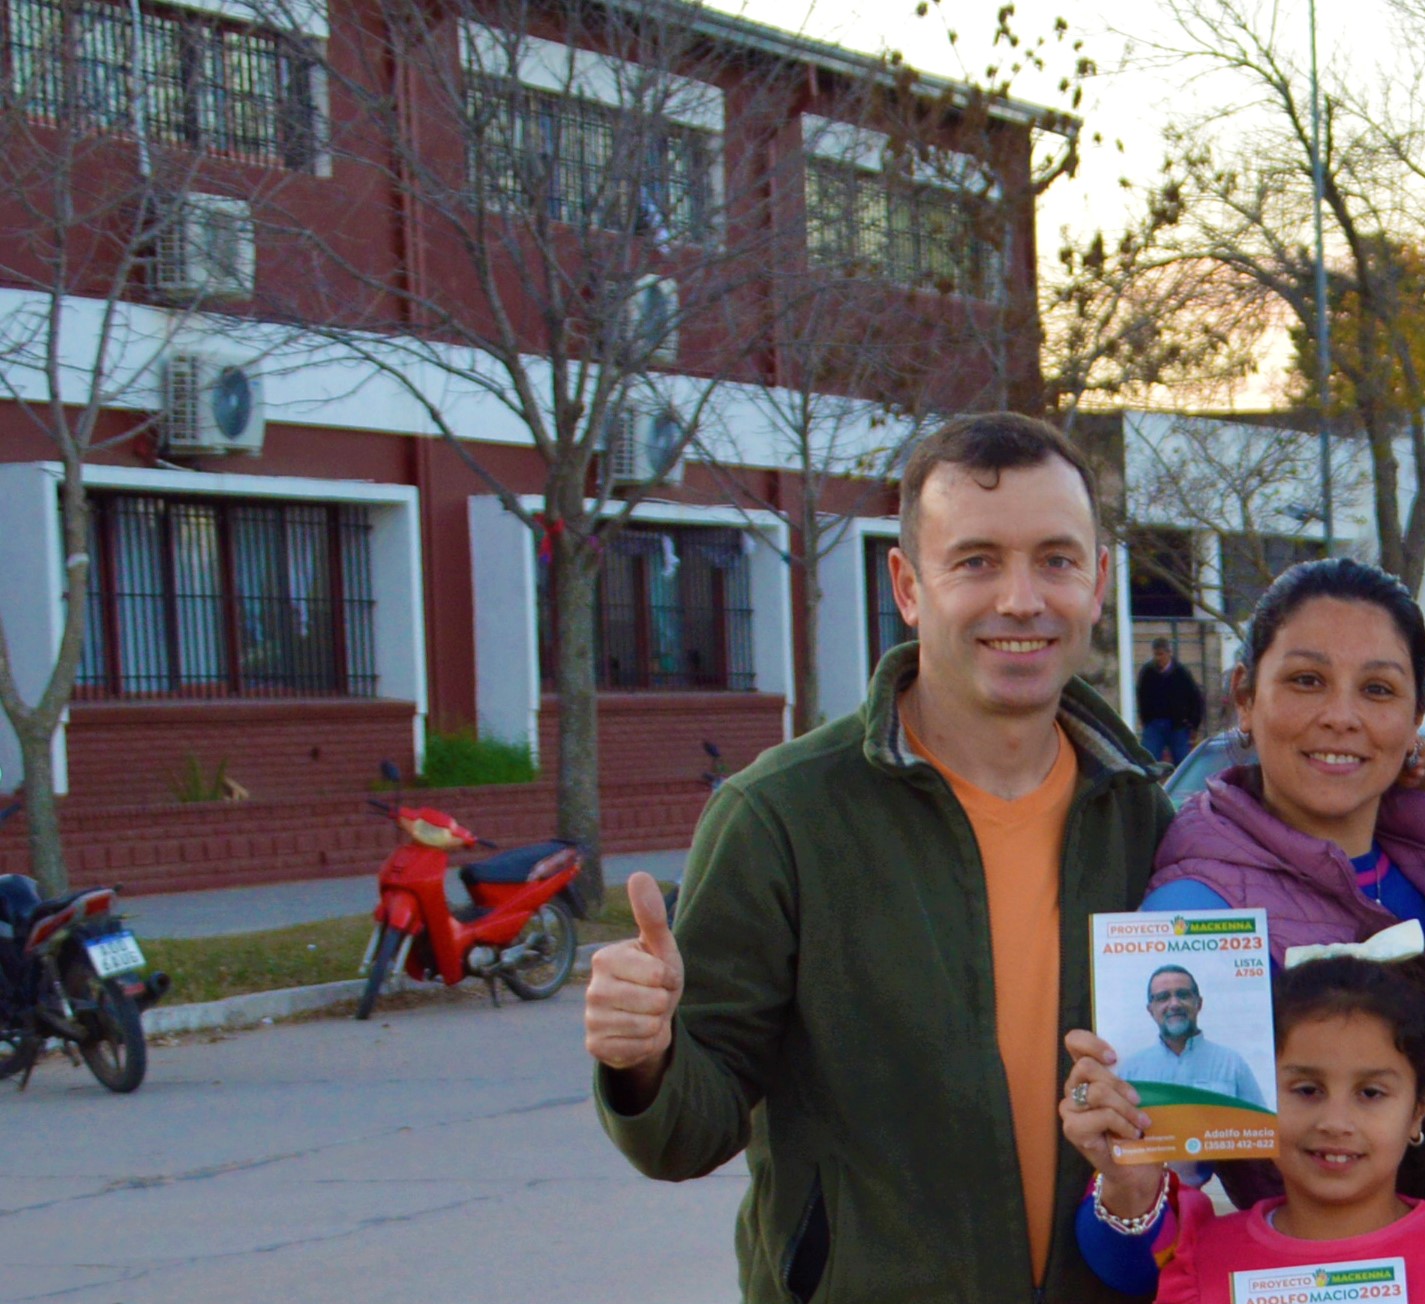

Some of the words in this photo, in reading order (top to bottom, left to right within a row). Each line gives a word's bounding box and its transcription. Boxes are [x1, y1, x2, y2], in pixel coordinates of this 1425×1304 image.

[1110, 923, 1170, 935] PROYECTO
[1190, 920, 1253, 932] MACKENNA
[1234, 958, 1264, 968] LISTA
[1204, 1129, 1240, 1138] Adolfo
[1243, 1128, 1275, 1137] Macio
[1252, 1276, 1311, 1290] PROYECTO
[1331, 1270, 1392, 1283] MACKENNA
